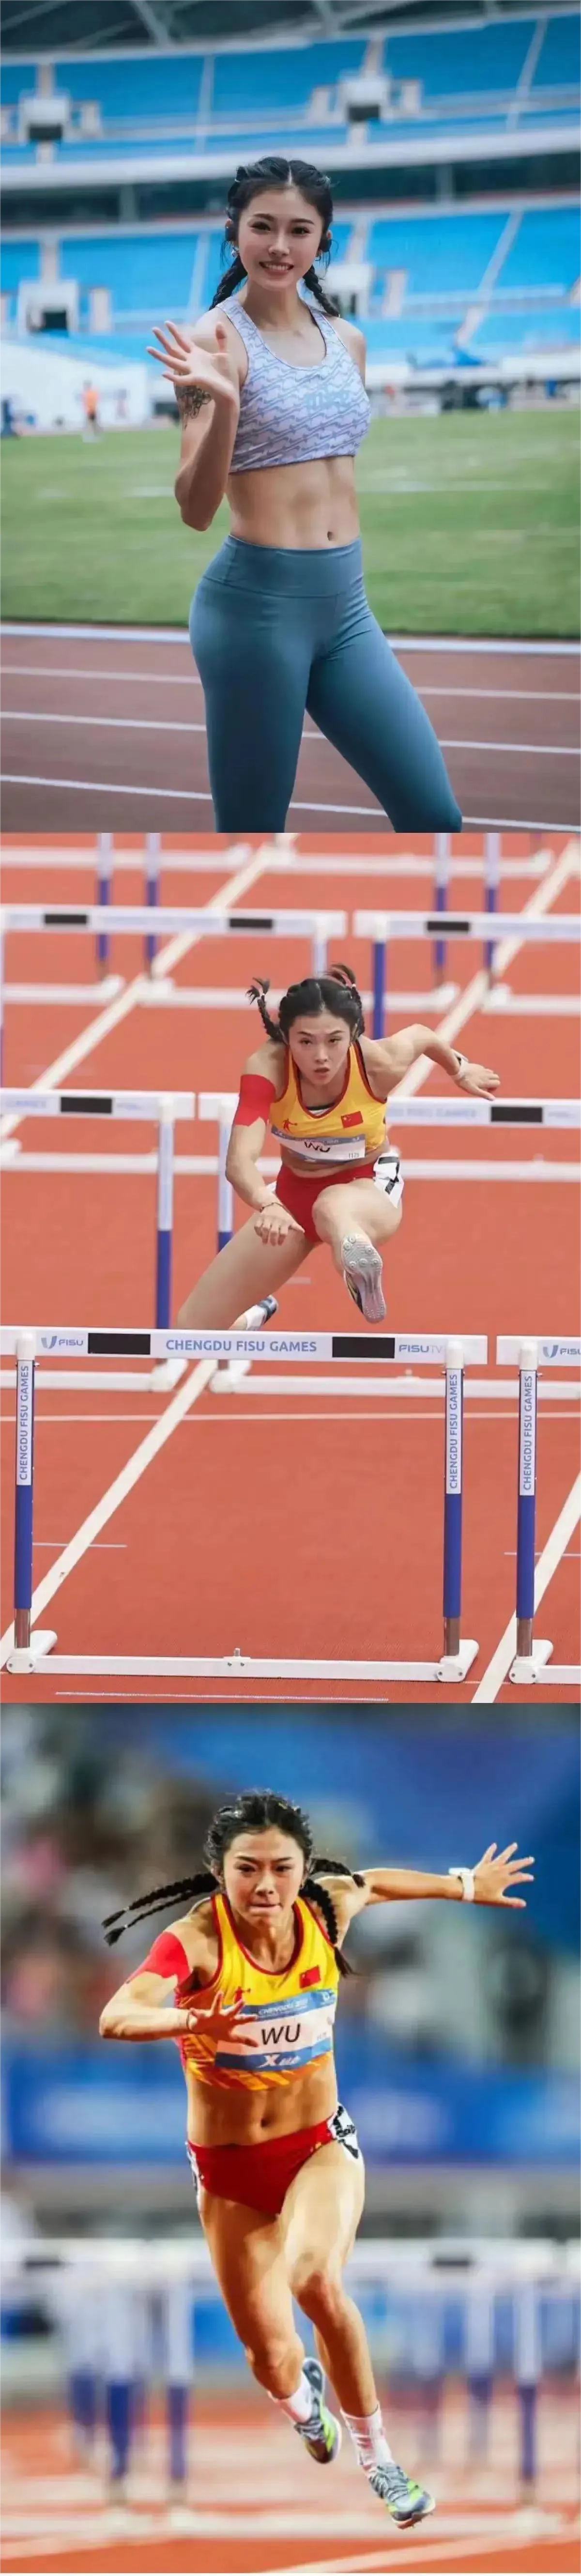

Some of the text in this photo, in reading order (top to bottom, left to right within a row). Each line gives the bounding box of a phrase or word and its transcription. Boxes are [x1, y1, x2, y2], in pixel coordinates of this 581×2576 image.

[166, 1339, 317, 1352] CHENGDU FISU GAMES
[19, 1365, 29, 1480] CHENGDU FISU GAMES
[449, 1374, 458, 1488] CHENGDU FISU GAMES
[523, 1375, 533, 1490] CHENGDU FISU GAMES
[261, 2023, 301, 2045] WU
